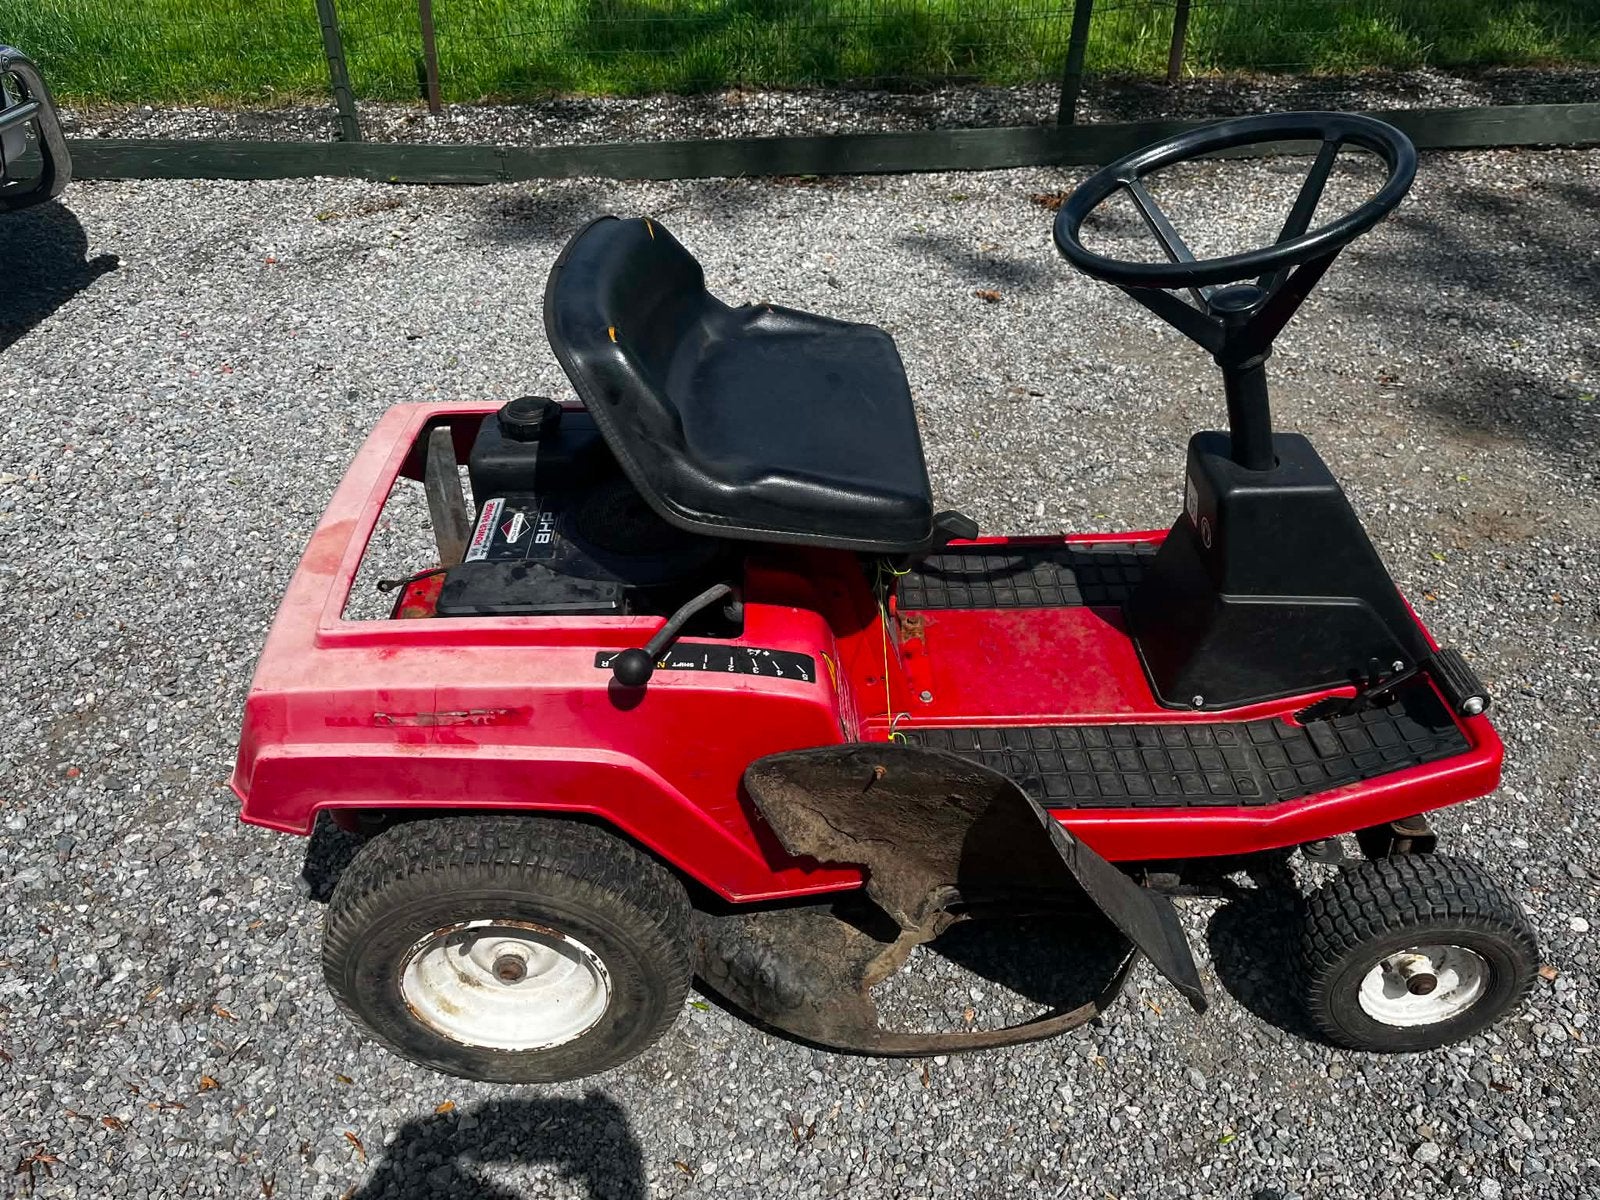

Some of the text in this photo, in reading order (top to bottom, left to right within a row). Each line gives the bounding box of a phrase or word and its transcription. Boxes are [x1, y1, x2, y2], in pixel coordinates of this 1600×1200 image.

[534, 512, 554, 544] 8HP
[473, 522, 488, 546] POWER
[601, 660, 610, 668] R
[656, 661, 666, 669] N
[702, 662, 707, 670] 1
[727, 664, 735, 672] 2
[752, 666, 760, 674] 3
[801, 673, 809, 681] 5
